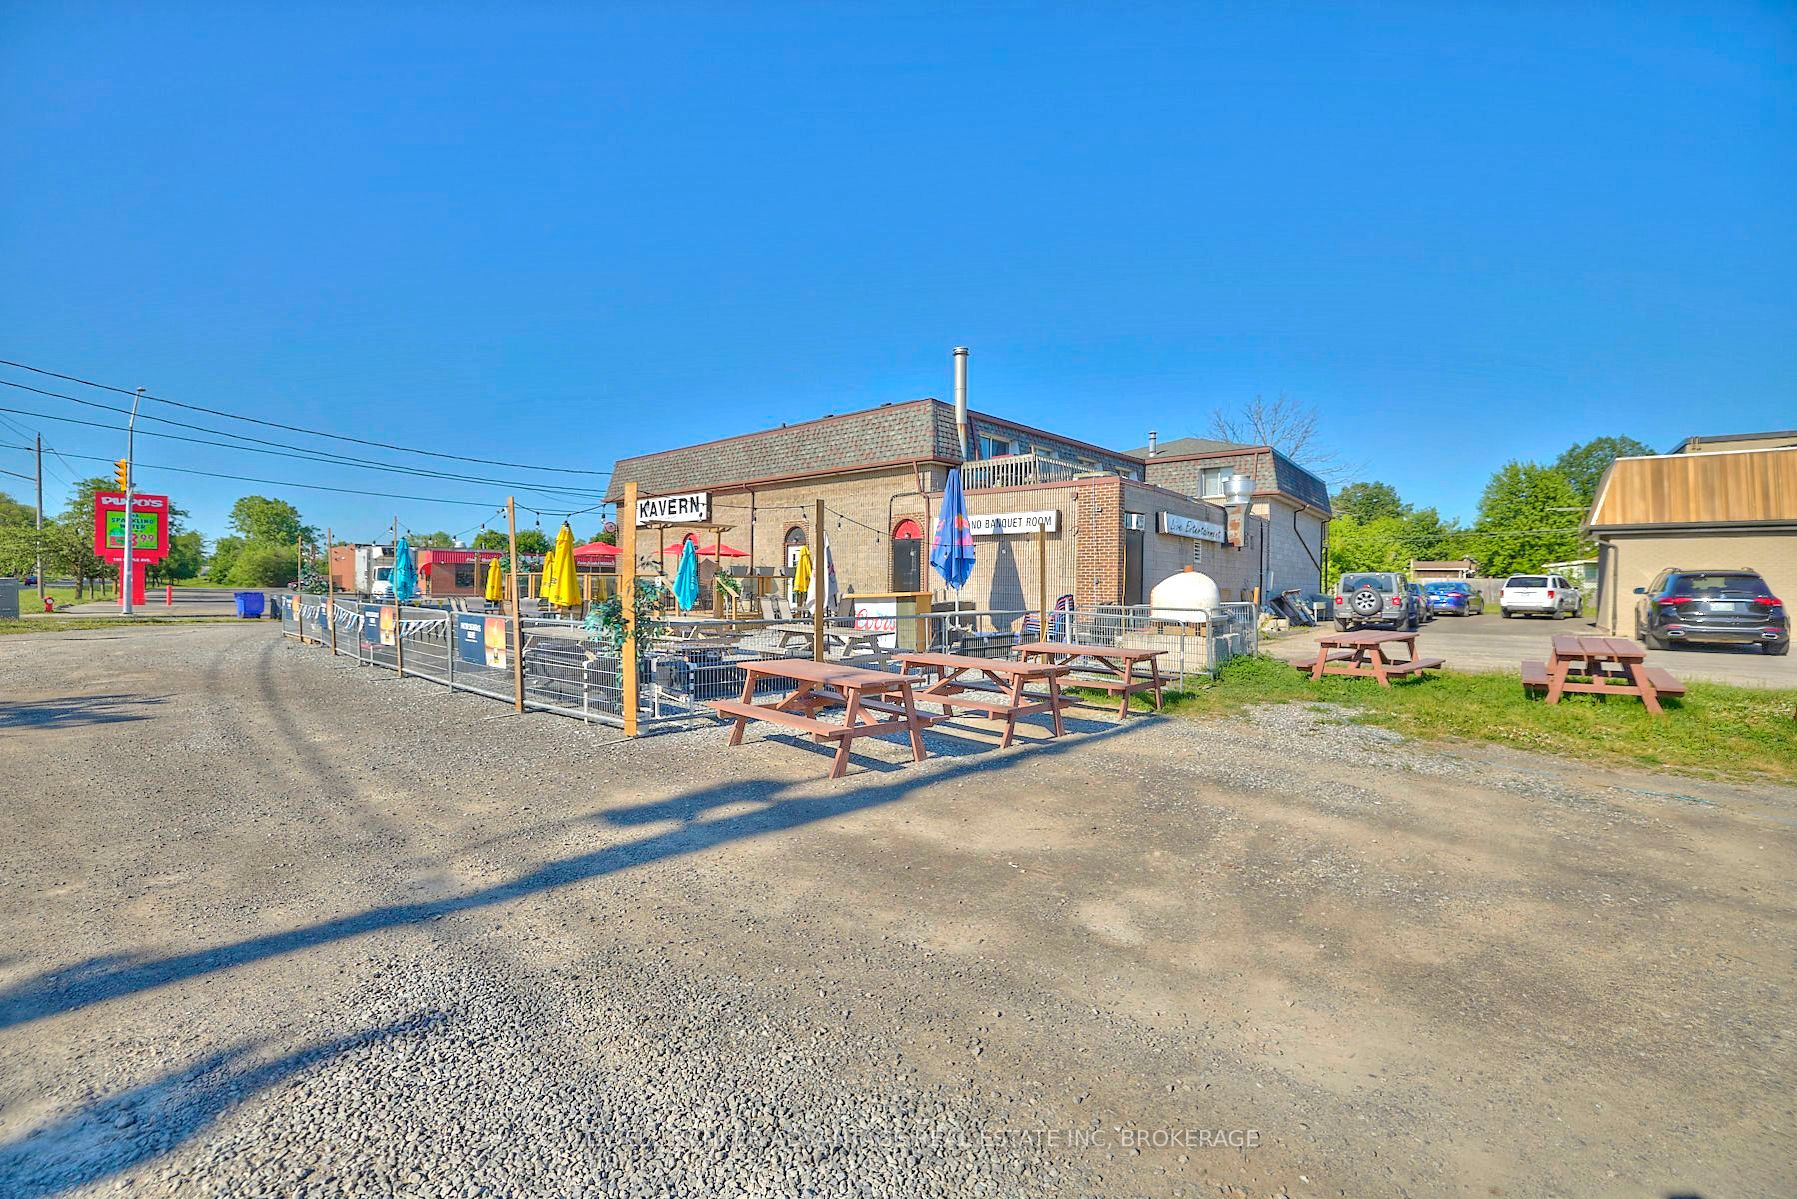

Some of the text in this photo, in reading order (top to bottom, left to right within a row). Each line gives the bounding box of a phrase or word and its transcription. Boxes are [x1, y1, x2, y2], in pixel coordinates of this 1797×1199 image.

[640, 496, 699, 518] KAVERN
[985, 517, 1022, 529] BANQUET
[1026, 516, 1052, 527] ROOM
